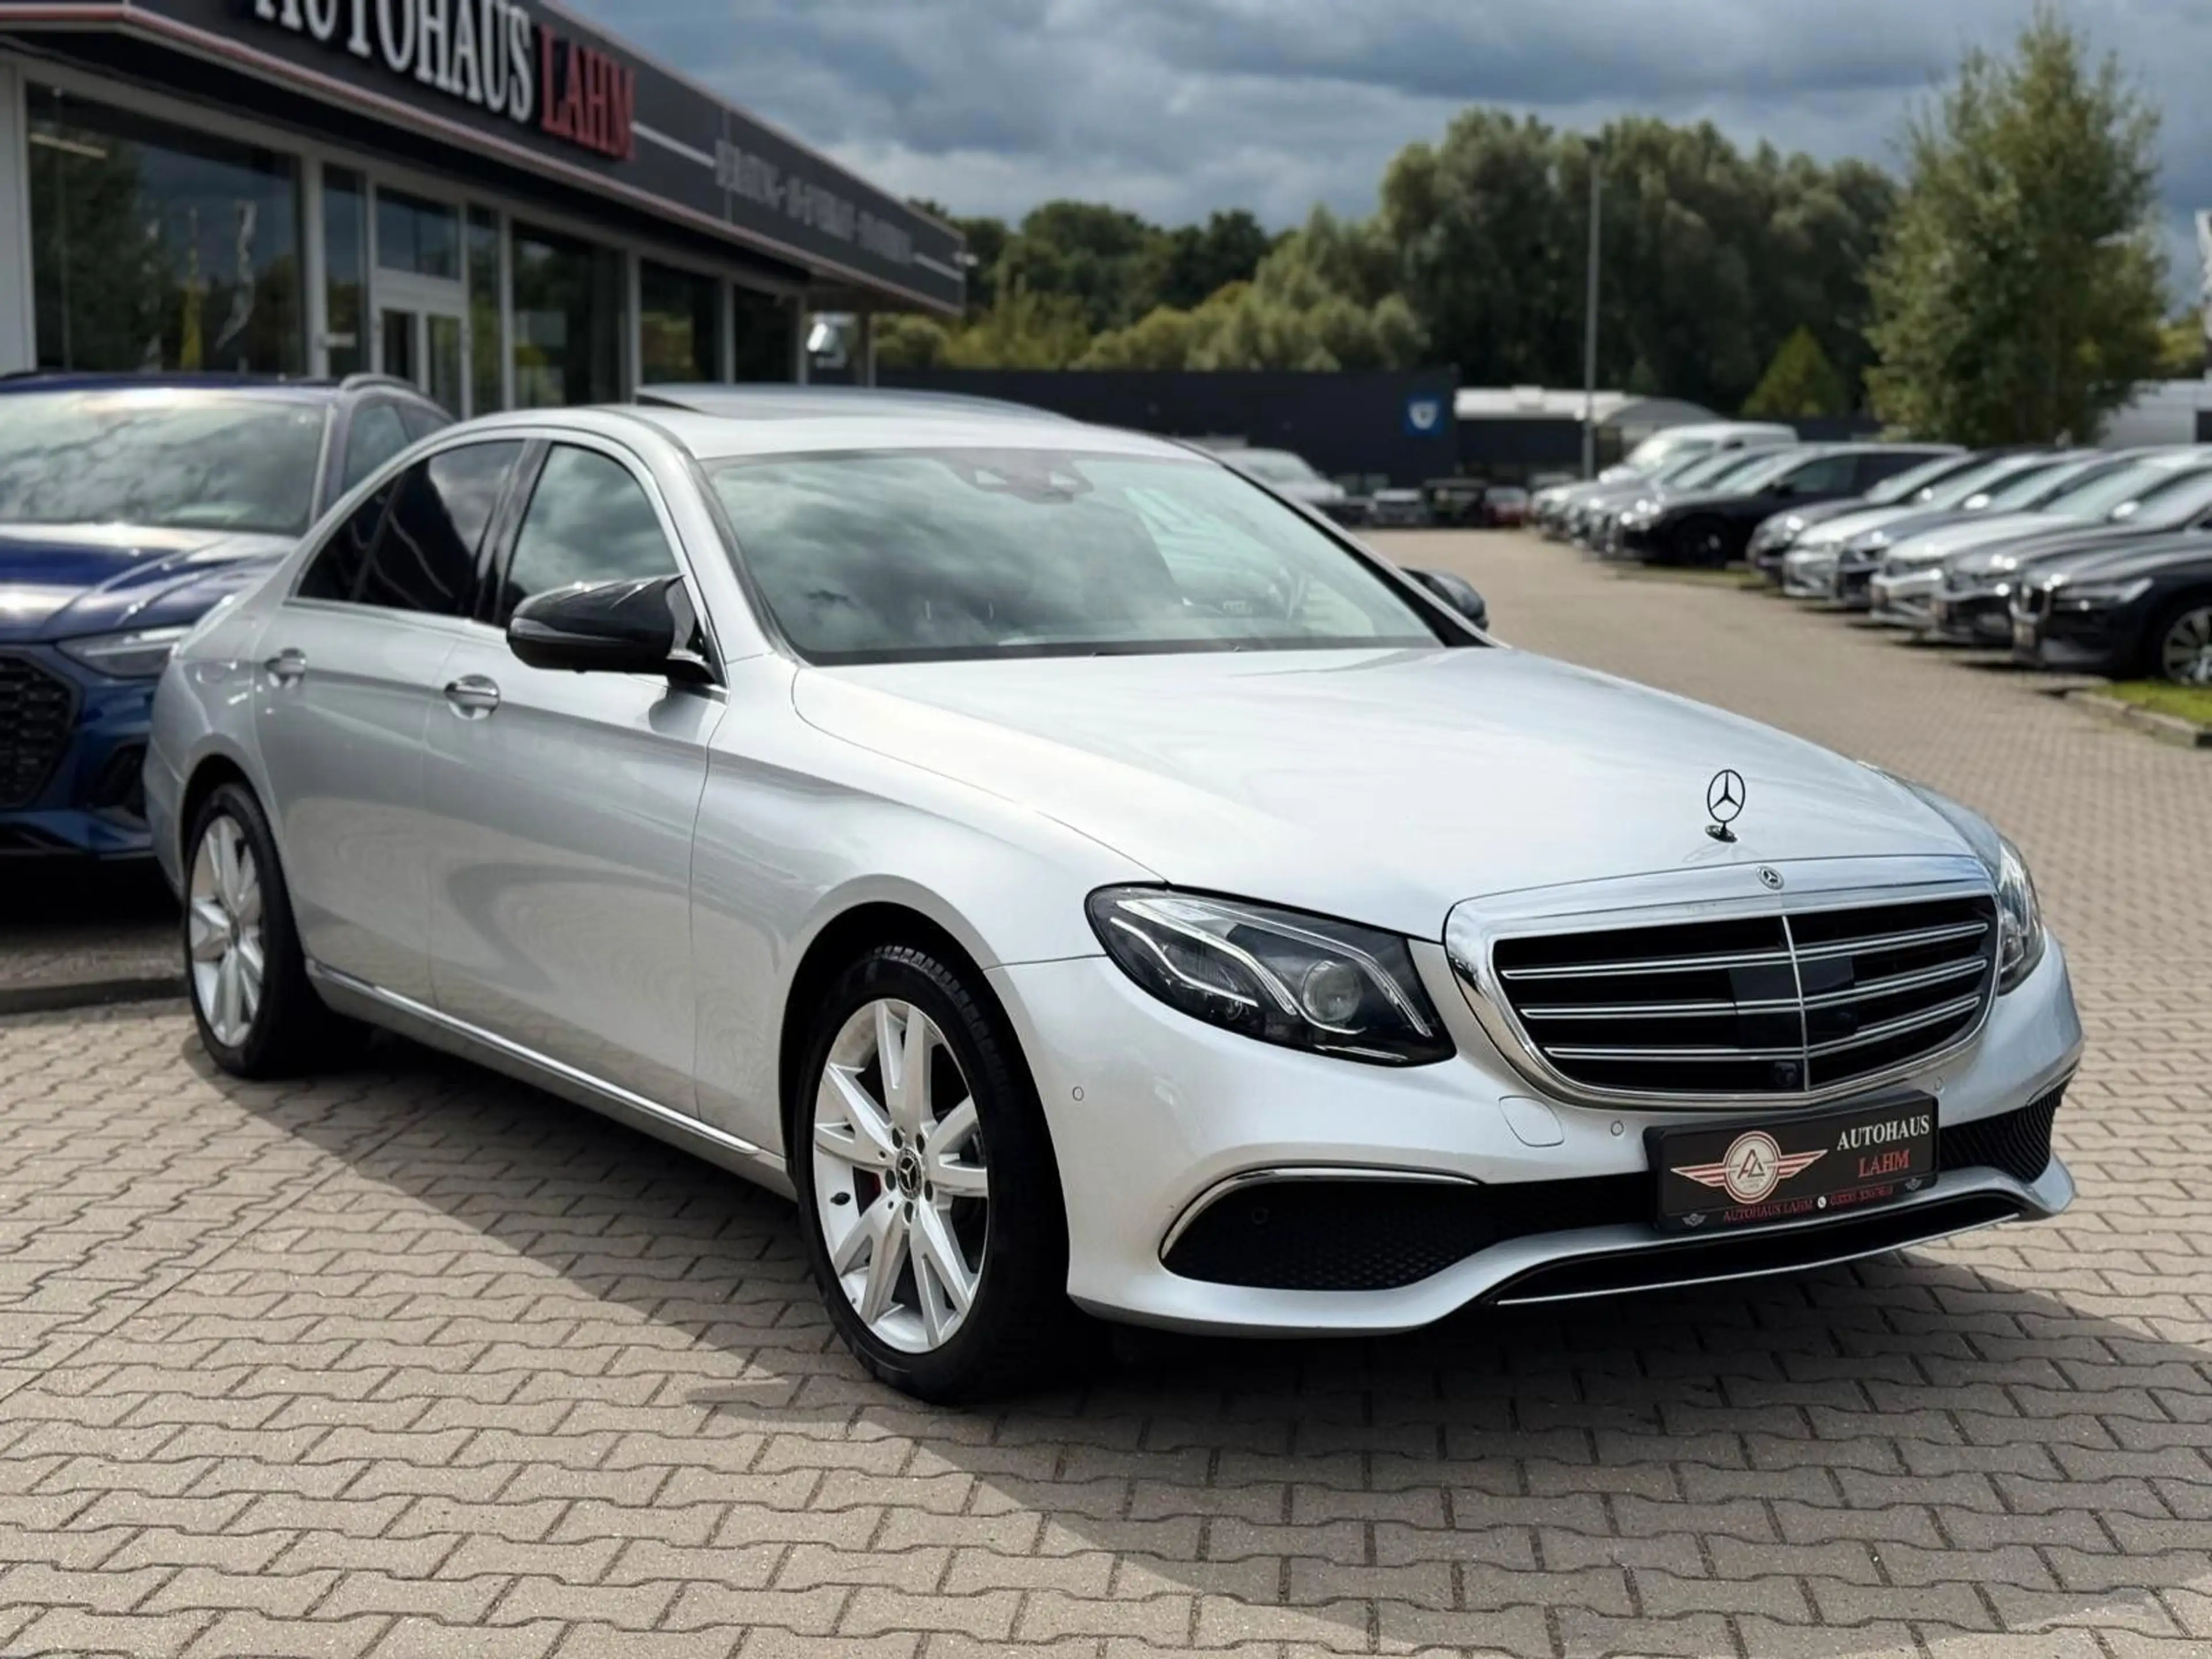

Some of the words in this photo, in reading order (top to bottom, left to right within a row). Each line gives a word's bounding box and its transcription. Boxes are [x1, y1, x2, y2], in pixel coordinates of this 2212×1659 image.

[255, 0, 533, 123] OHAUS
[538, 23, 634, 160] LAHM
[1836, 1115, 1929, 1151] AUTOHAUS
[1858, 1149, 1910, 1178] LAHM
